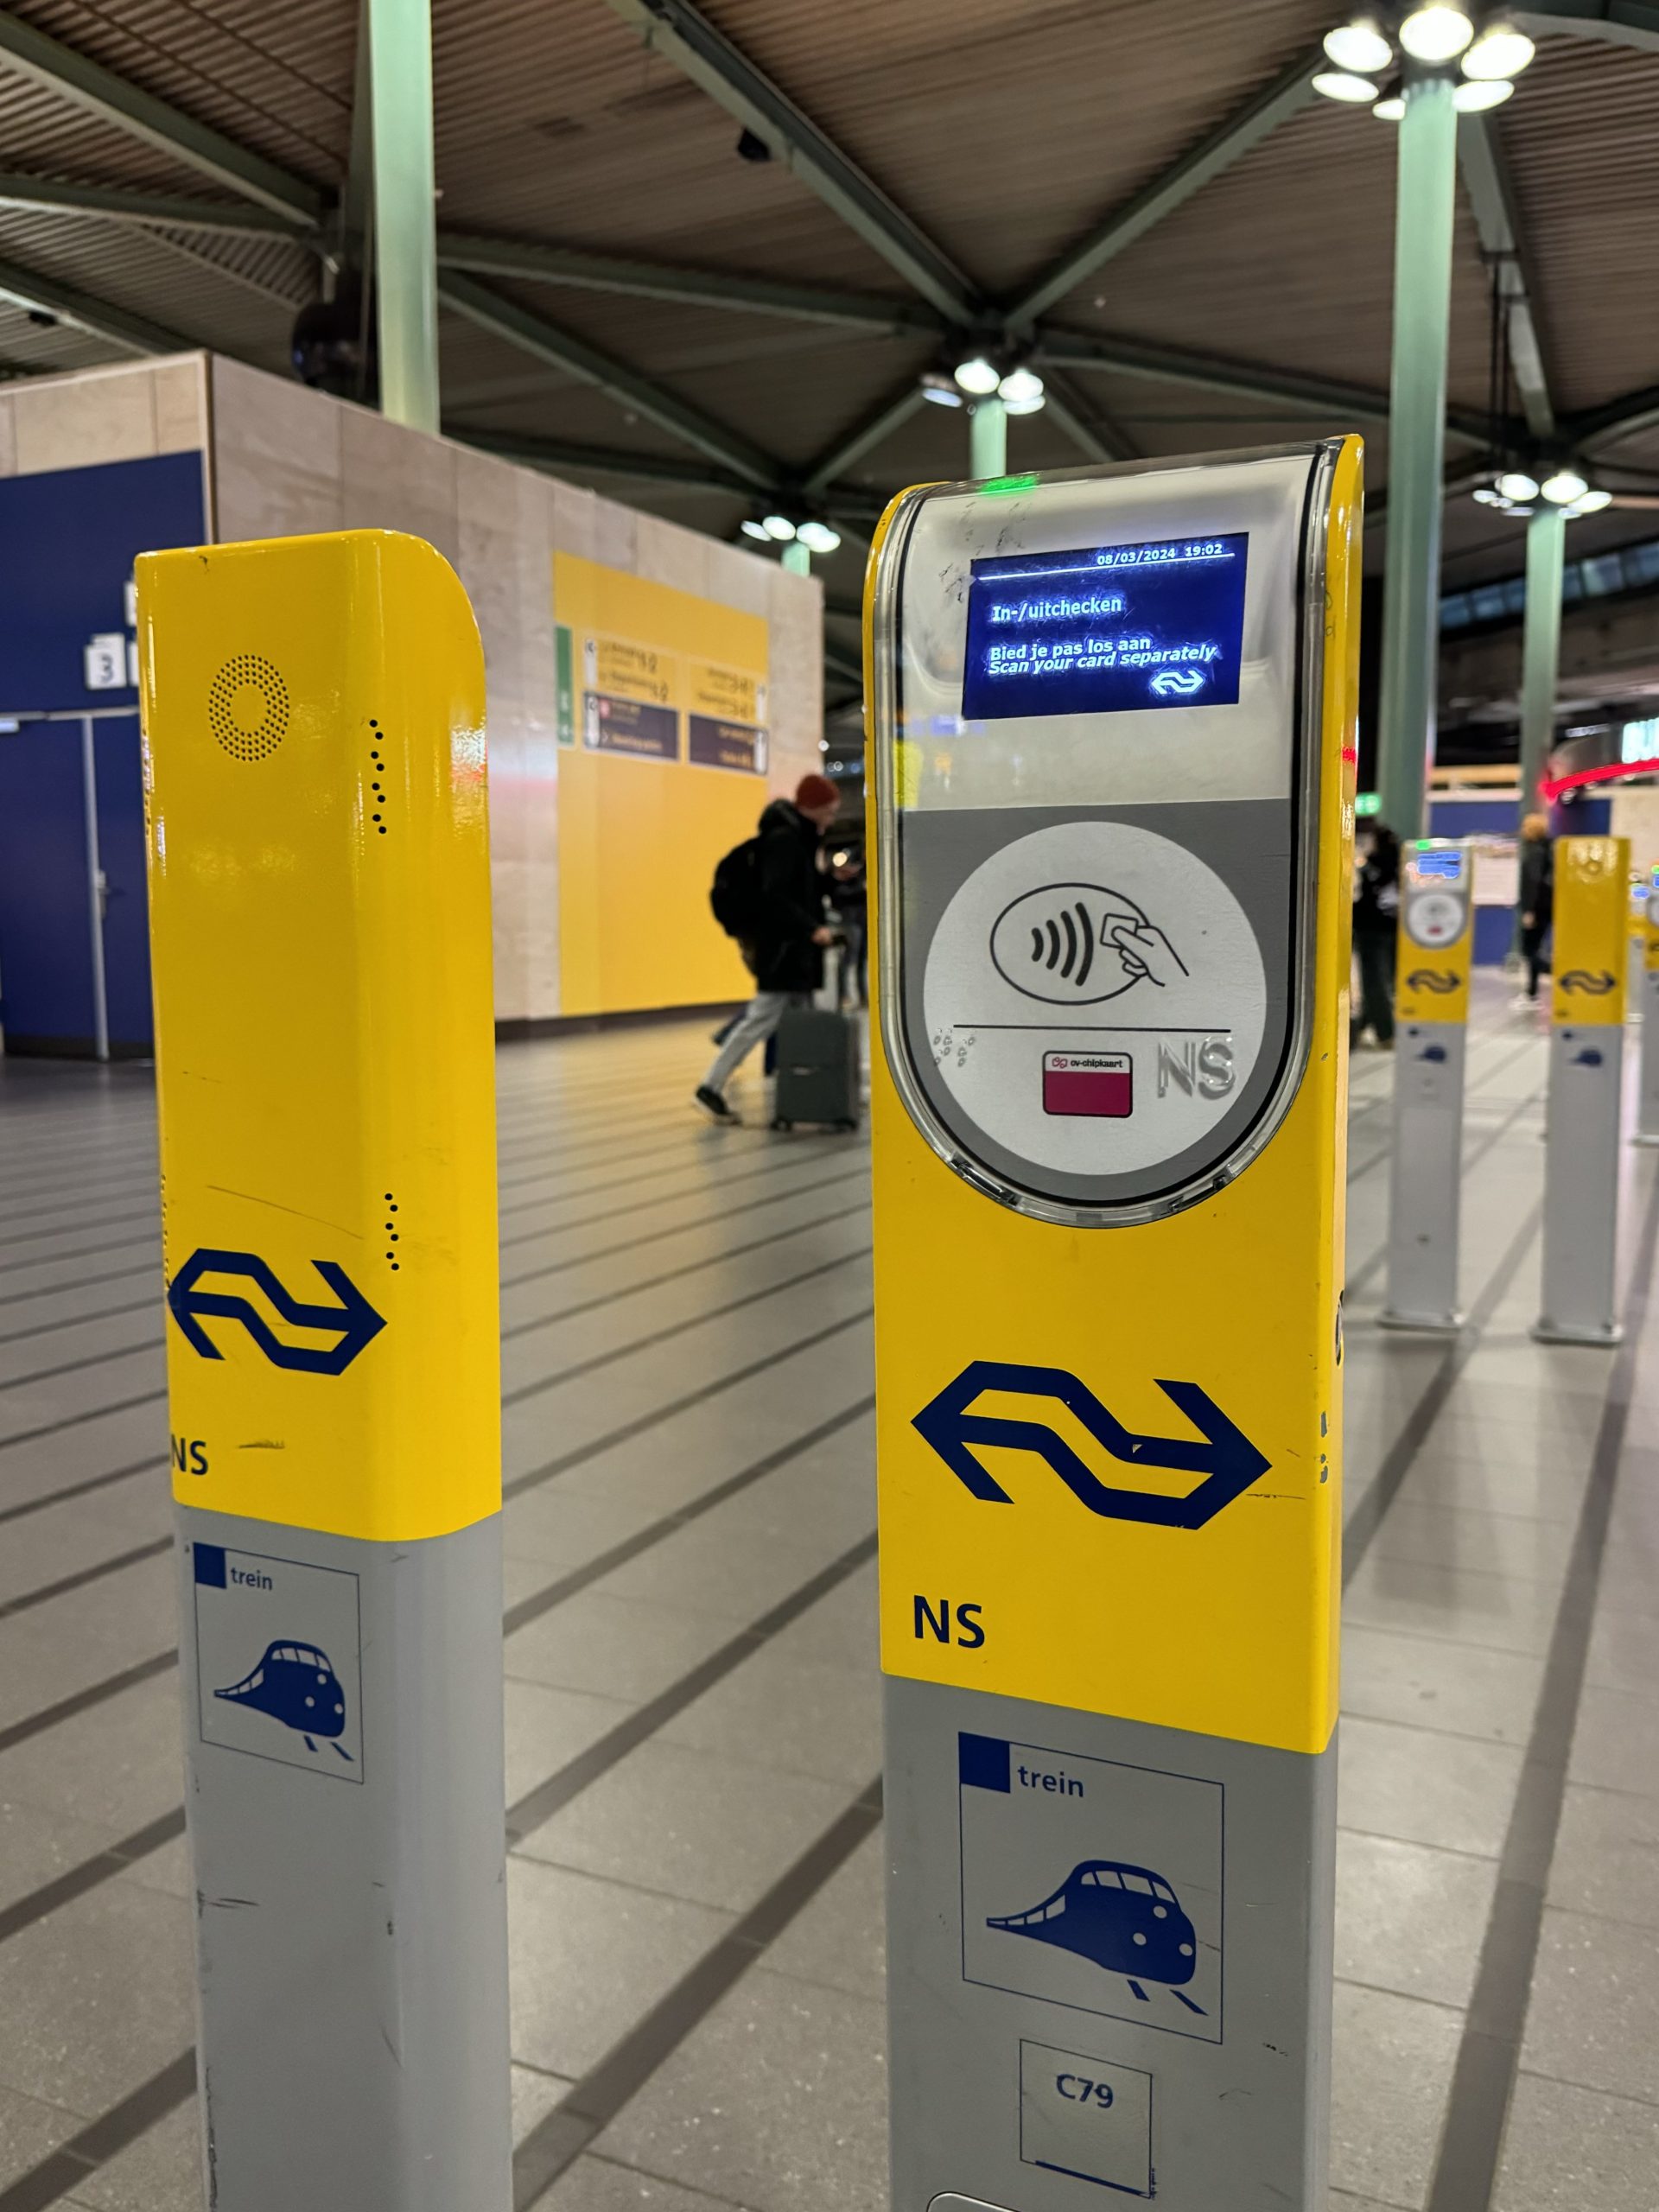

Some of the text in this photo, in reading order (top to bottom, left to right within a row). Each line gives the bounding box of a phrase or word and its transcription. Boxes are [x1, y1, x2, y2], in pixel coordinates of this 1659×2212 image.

[1096, 543, 1223, 565] 08/03/2024 19:02
[992, 598, 1122, 622] In-/uitchecken
[988, 644, 1217, 675] Scan your card separately
[990, 638, 1152, 662] Bied je pas los aan
[1070, 1058, 1123, 1068] ov-chipkaart
[1156, 1035, 1236, 1100] NS
[171, 1433, 209, 1476] NS
[230, 1566, 274, 1591] trein
[913, 1594, 986, 1649] NS
[1017, 1765, 1084, 1798] trein
[1055, 2073, 1114, 2109] C79
